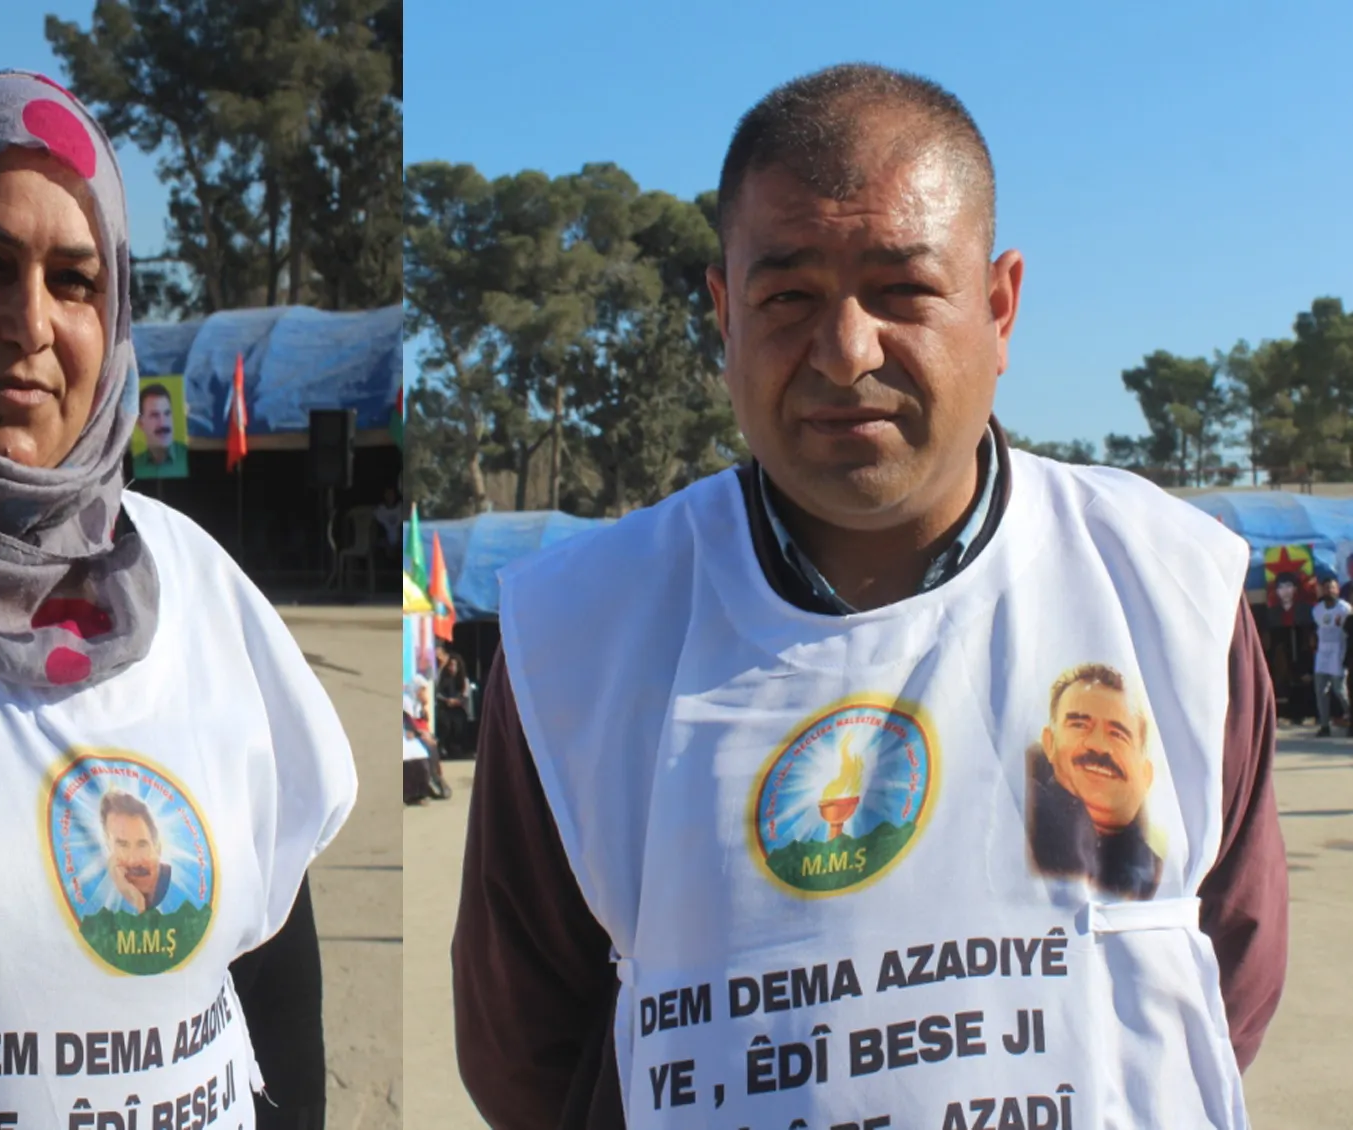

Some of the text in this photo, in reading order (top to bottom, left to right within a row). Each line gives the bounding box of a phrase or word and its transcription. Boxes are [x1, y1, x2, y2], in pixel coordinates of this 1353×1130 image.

[801, 848, 867, 876] M.M.Ş
[117, 928, 177, 957] M.M.Ş
[640, 927, 1068, 1037] DEM DEMA AZADIYÊ
[55, 1027, 164, 1076] DEMA
[649, 1059, 696, 1111] YE
[747, 1023, 833, 1095] ÊDÎ
[849, 1010, 987, 1078] BESE
[1002, 1009, 1047, 1056] JI
